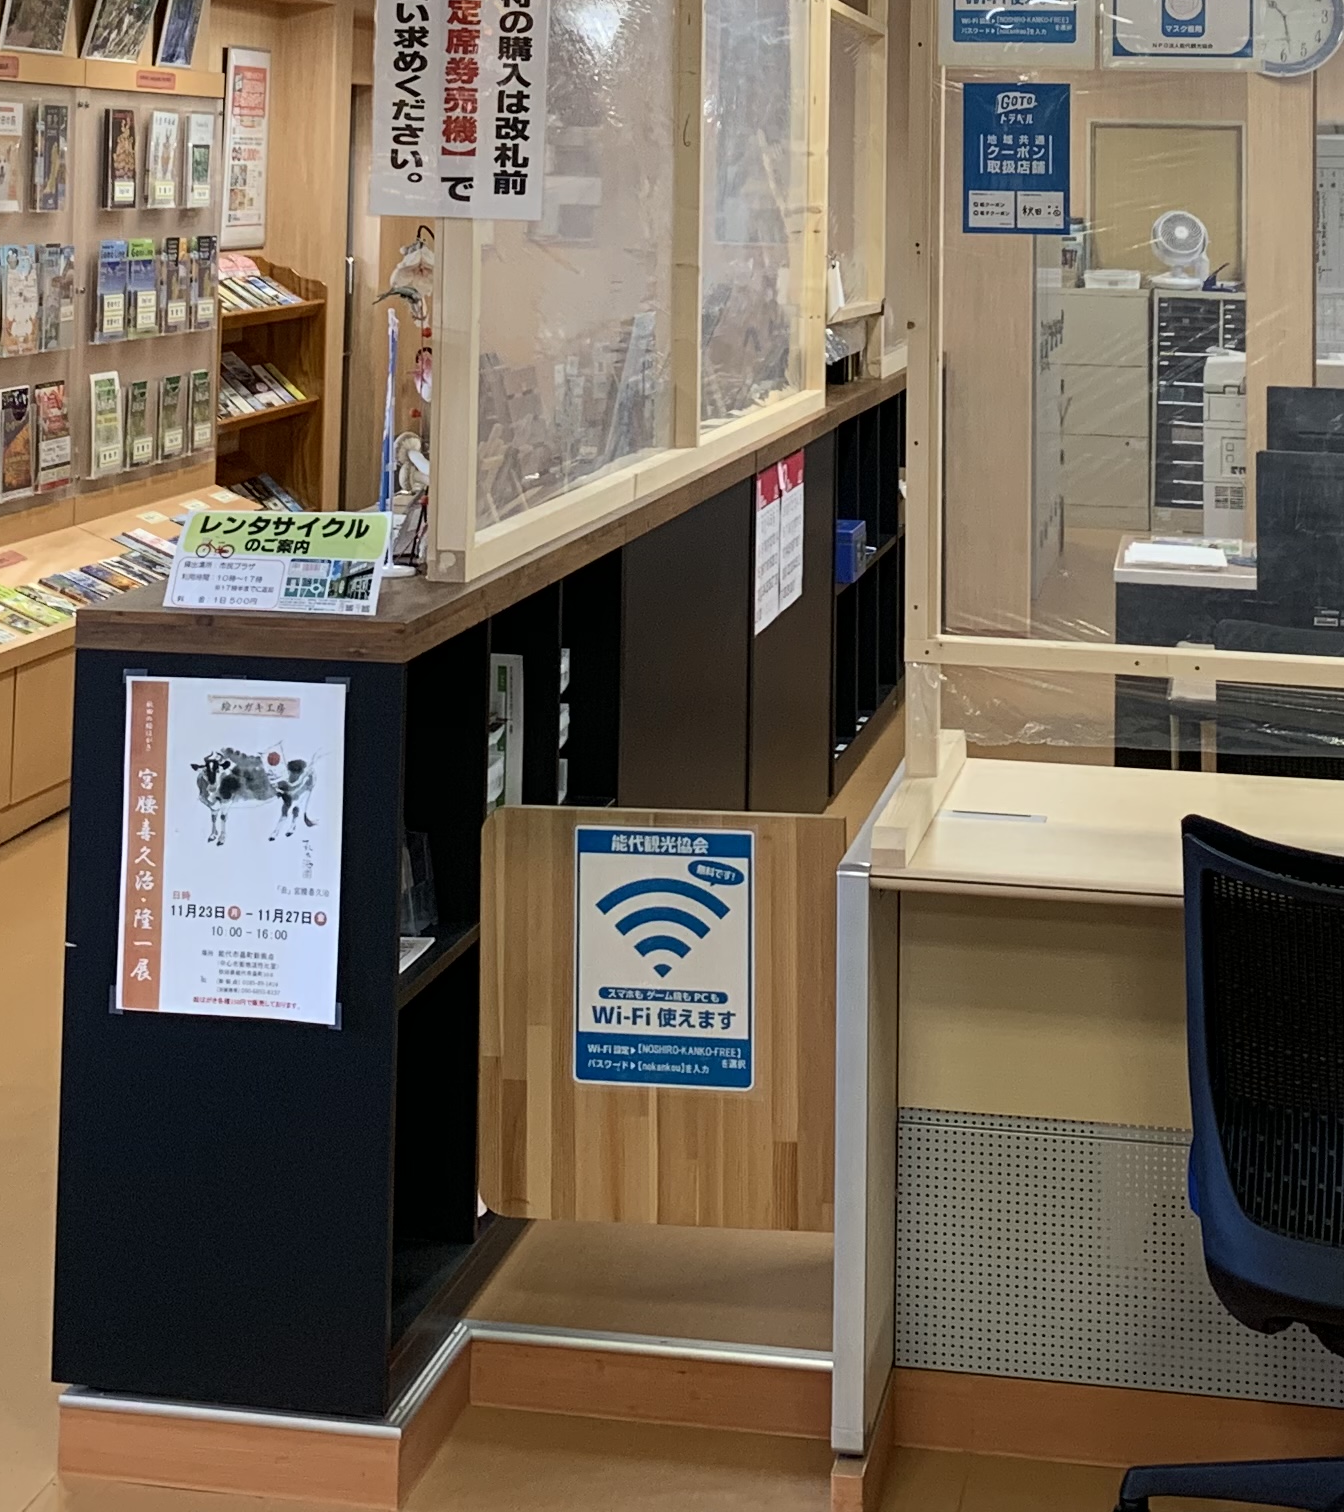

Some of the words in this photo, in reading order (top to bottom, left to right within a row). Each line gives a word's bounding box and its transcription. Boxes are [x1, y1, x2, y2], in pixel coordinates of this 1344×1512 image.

[1321, 9, 1328, 25] 3
[1314, 29, 1322, 44] 4
[1280, 48, 1288, 63] 6
[1300, 43, 1307, 57] 5
[1000, 113, 1034, 124] トラベル
[987, 134, 1045, 145] 地域共通
[987, 146, 1045, 159] クーポン
[987, 160, 1046, 175] 取扱店舗
[200, 515, 370, 539] レンタサイクル
[244, 538, 310, 554] のご案内
[611, 834, 709, 855] 能代観光協会
[172, 890, 191, 901] 日時
[694, 993, 709, 1003] PC
[711, 993, 720, 1003] も
[592, 1005, 652, 1027] Wi-Fi
[657, 1007, 737, 1031] 使えます
